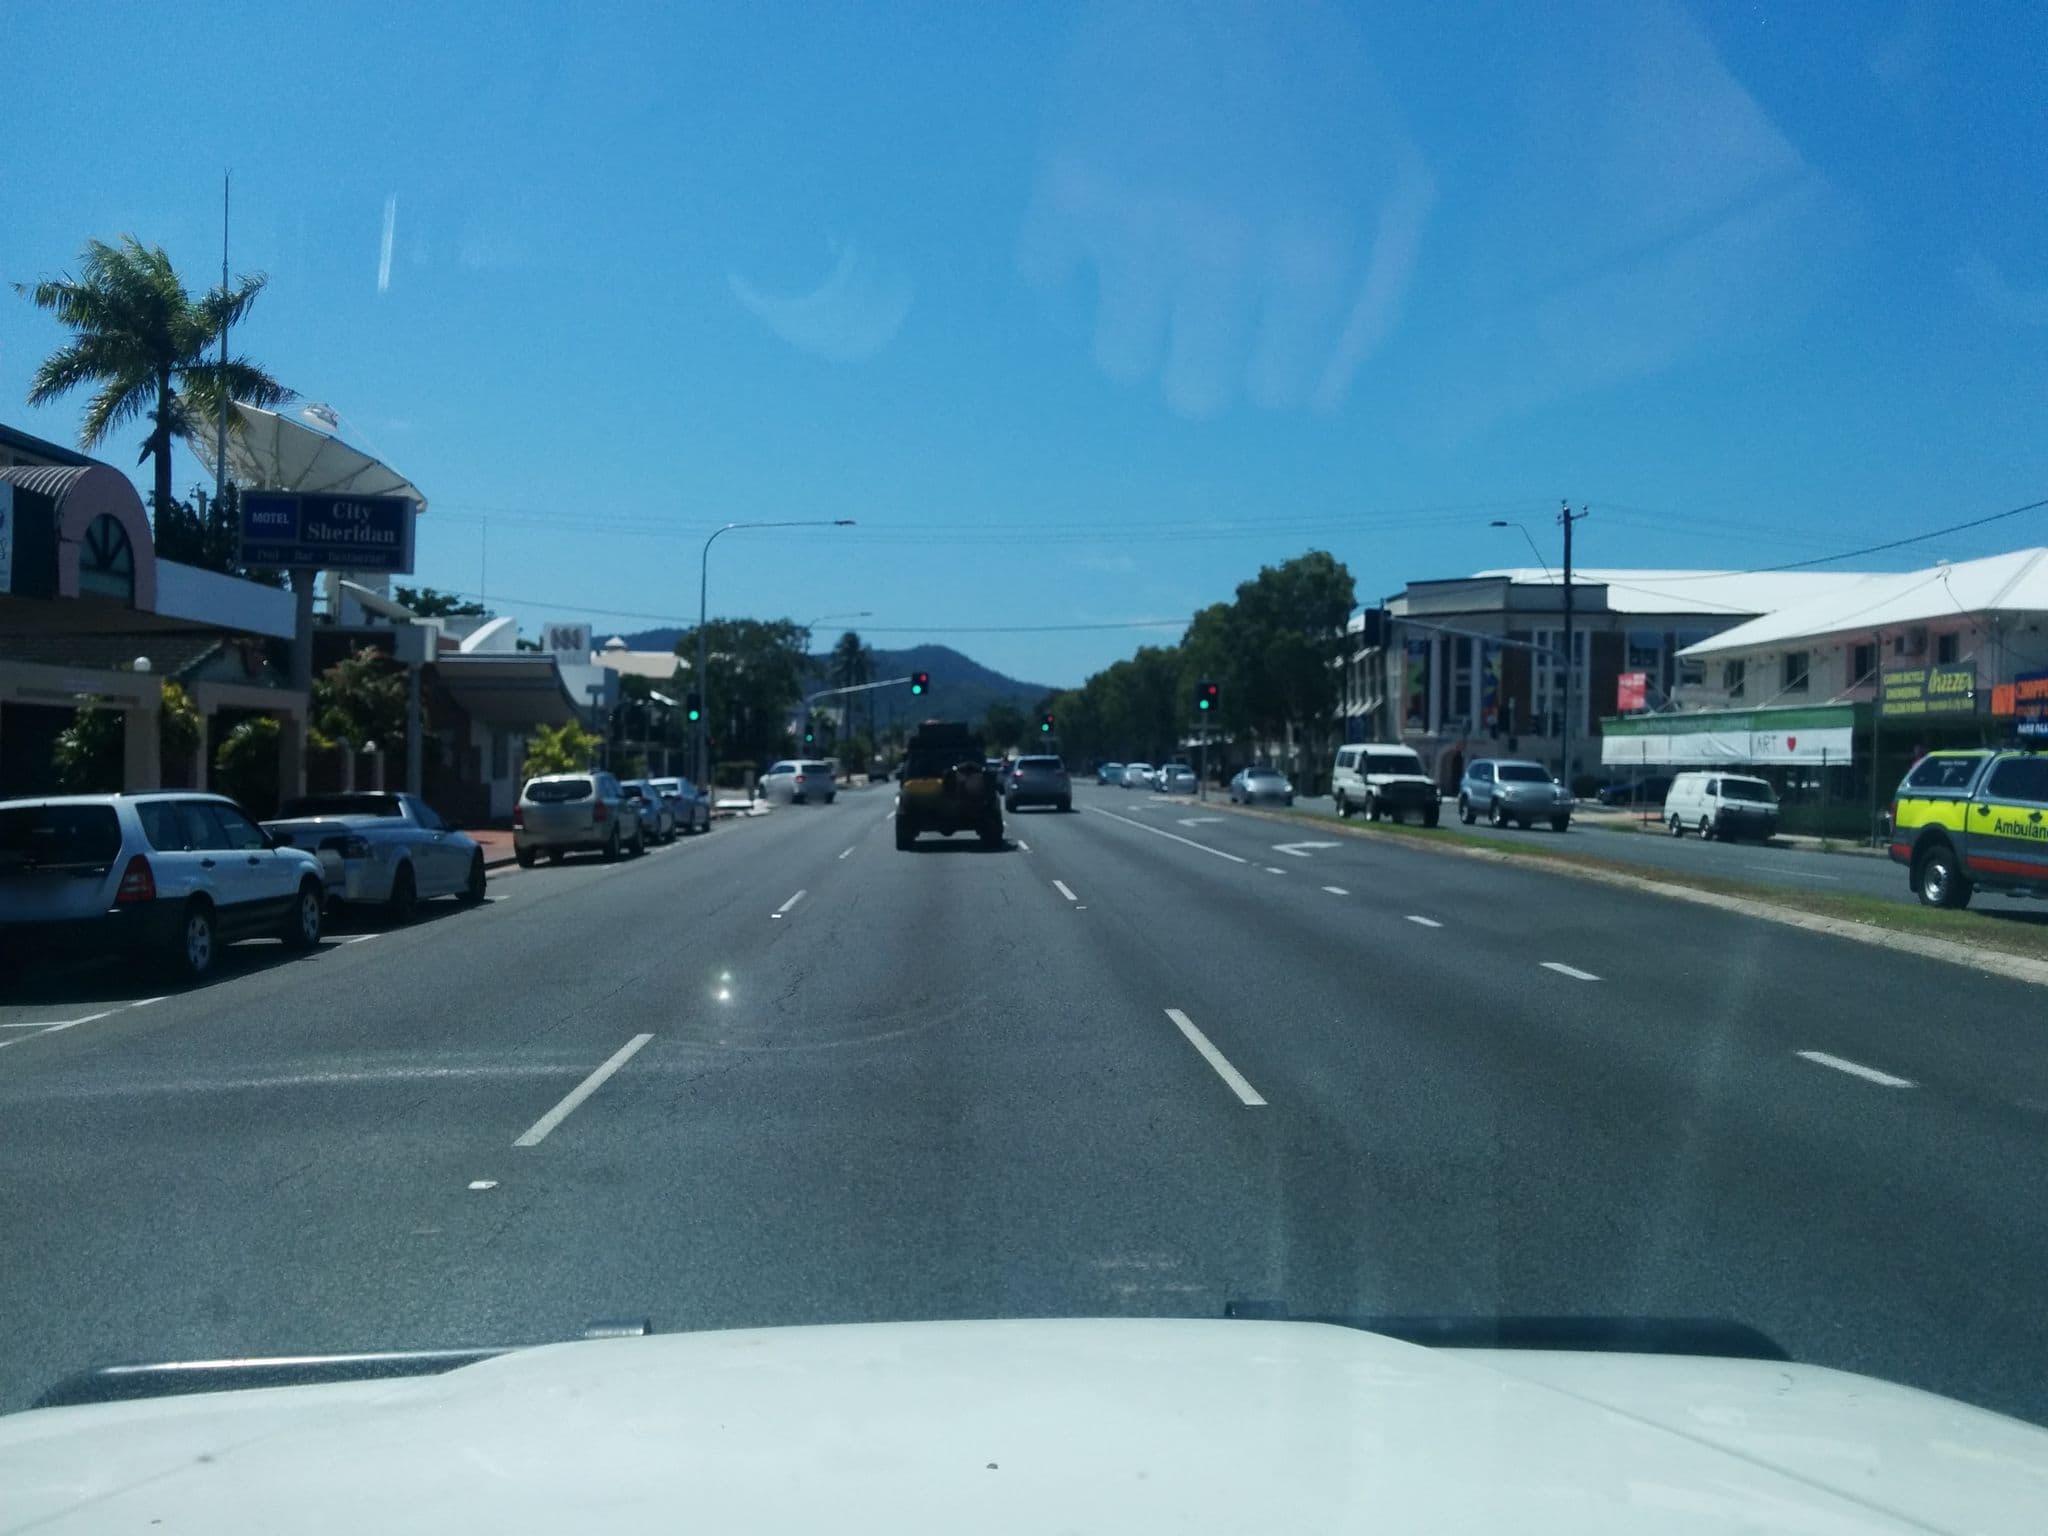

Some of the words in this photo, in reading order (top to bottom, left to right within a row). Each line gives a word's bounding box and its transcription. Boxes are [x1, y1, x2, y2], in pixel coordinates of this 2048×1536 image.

[252, 512, 290, 525] MOTEL
[333, 502, 373, 524] City
[306, 522, 396, 544] Sheridan
